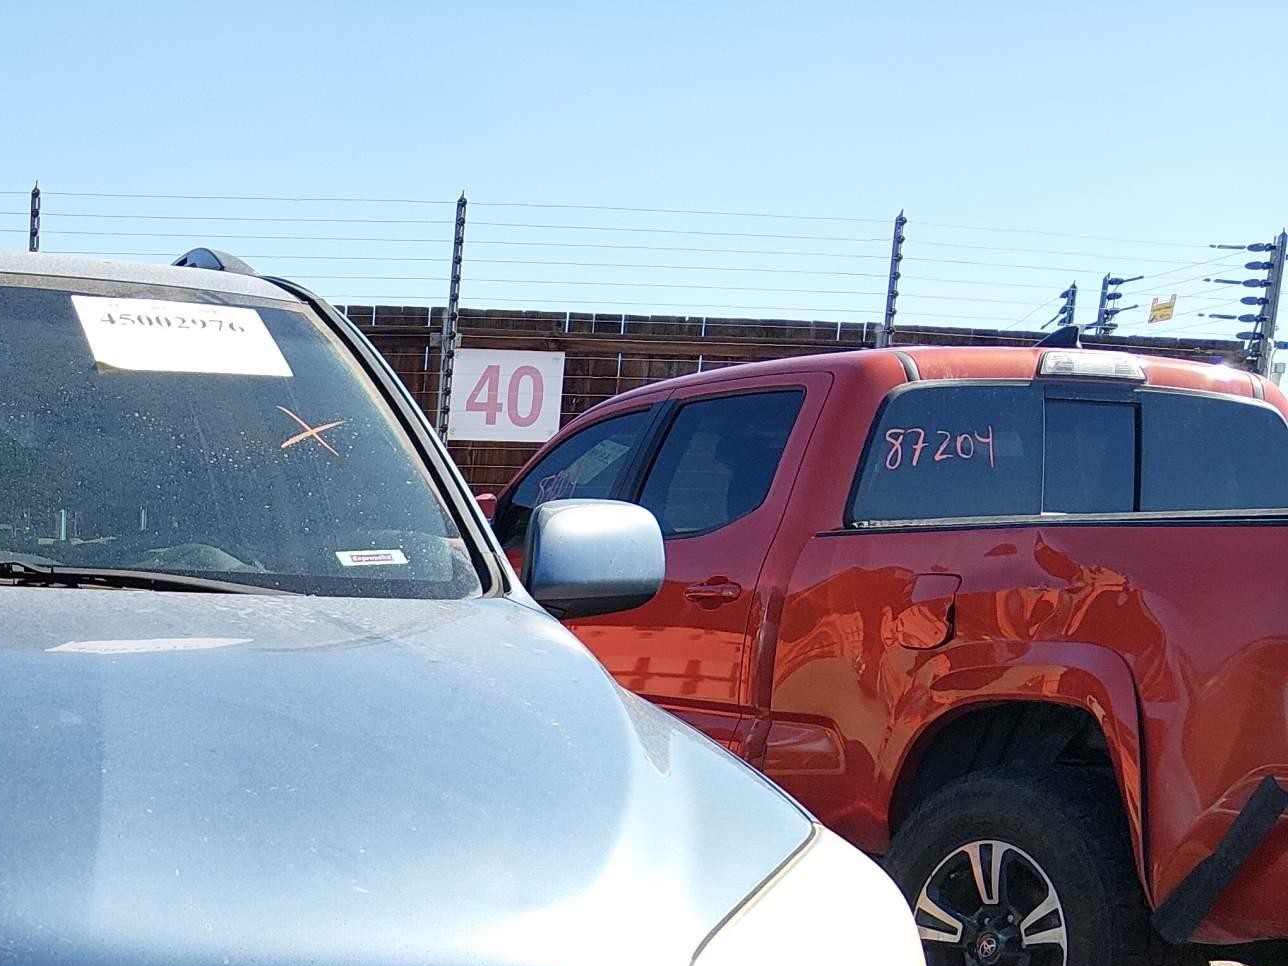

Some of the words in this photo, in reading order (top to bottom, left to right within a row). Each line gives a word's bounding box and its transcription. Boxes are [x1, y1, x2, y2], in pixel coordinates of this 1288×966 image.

[99, 311, 246, 333] 45002976
[465, 364, 544, 428] 40
[885, 425, 995, 470] 87204
